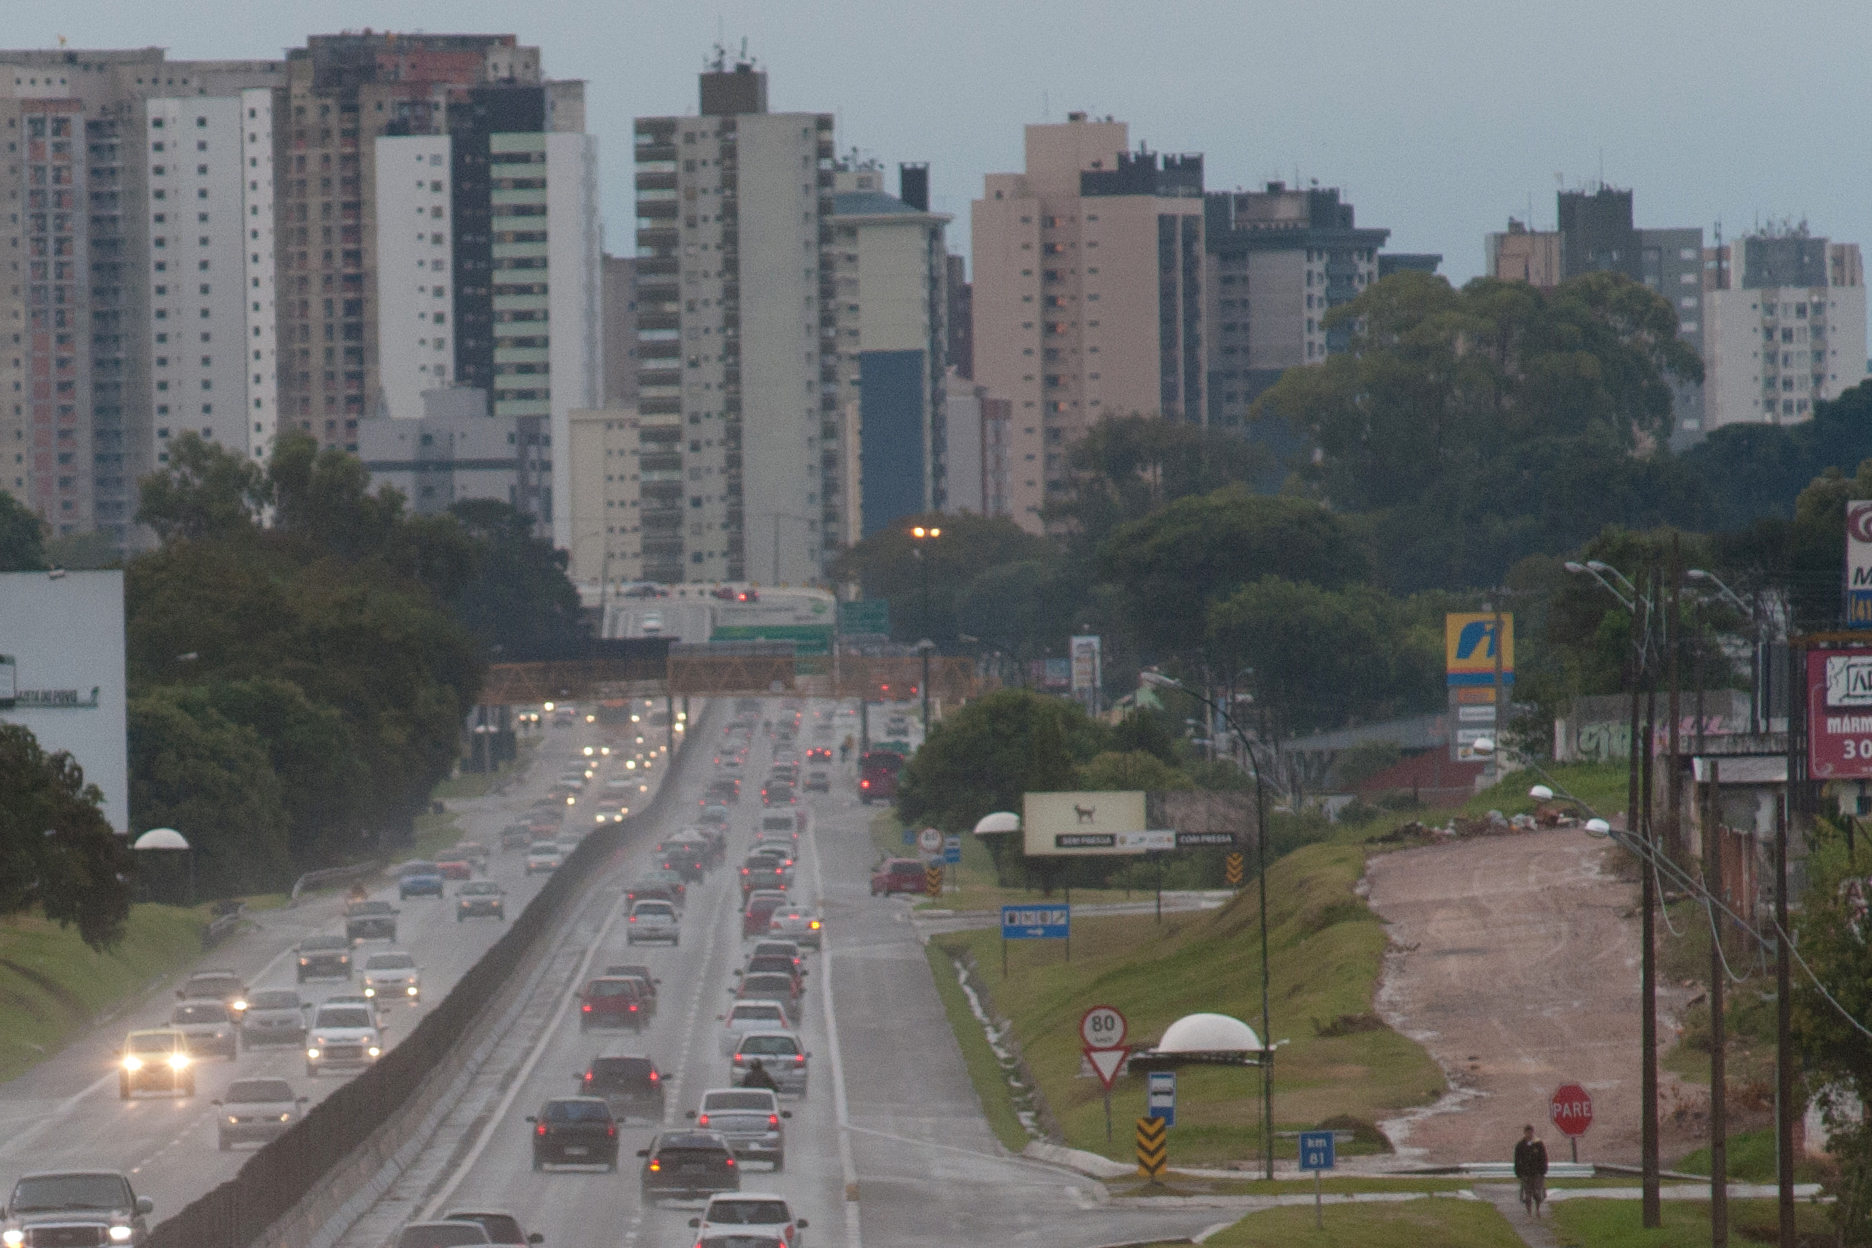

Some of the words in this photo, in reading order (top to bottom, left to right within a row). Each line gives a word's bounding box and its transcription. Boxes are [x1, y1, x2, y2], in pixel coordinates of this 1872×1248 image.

[1091, 1015, 1115, 1032] 80
[1553, 1101, 1592, 1118] PARE
[1308, 1138, 1327, 1148] km
[1309, 1152, 1325, 1165] 81
